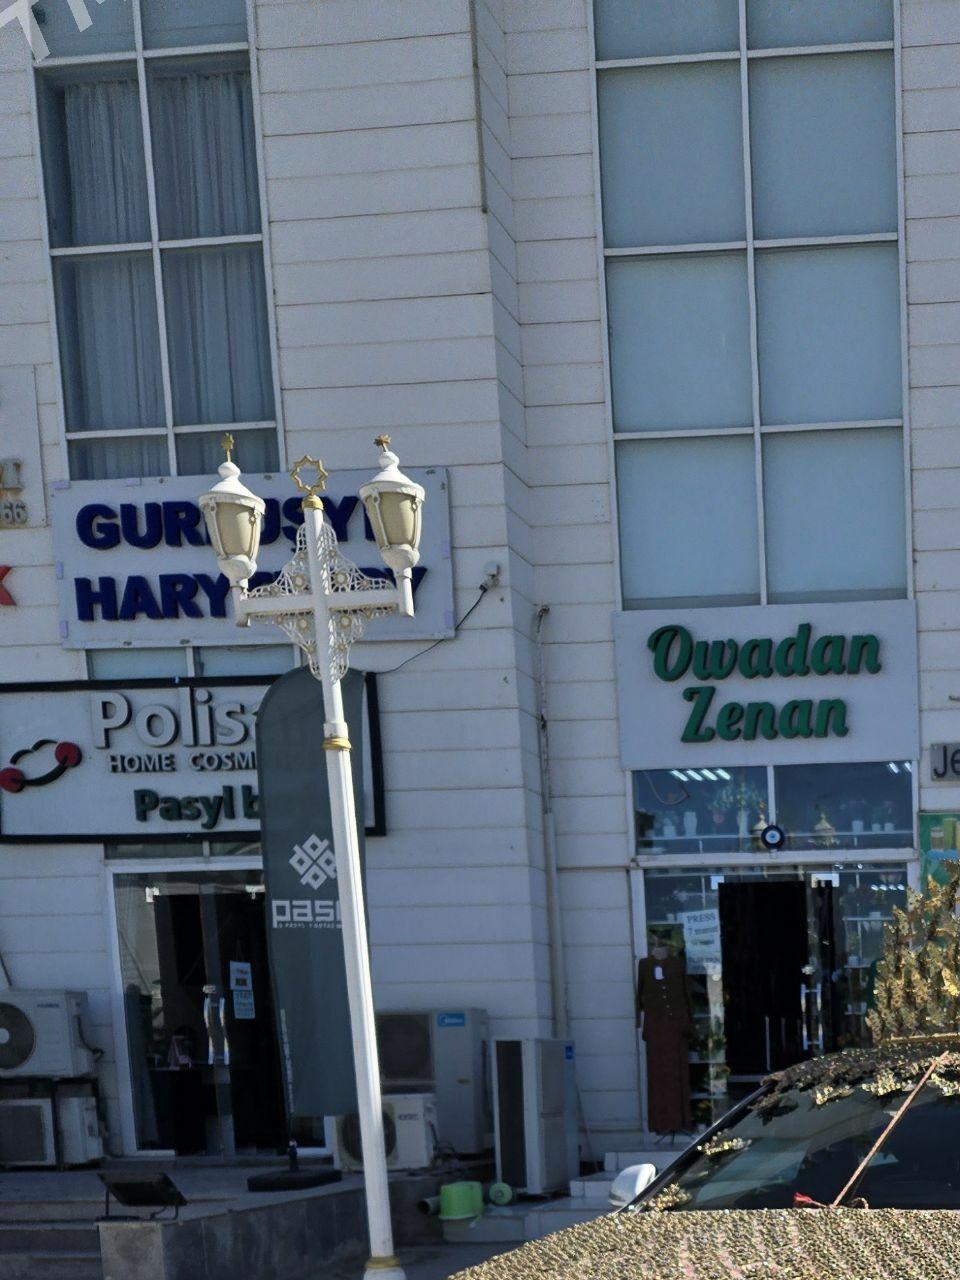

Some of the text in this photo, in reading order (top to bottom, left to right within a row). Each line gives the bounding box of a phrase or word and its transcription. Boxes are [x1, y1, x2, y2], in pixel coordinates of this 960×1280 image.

[647, 622, 883, 682] Owadan
[91, 685, 258, 749] Polis
[680, 685, 849, 743] Zenan
[109, 750, 257, 773] HOME COSM
[134, 785, 236, 830] Pasyl
[686, 912, 717, 925] PRESS
